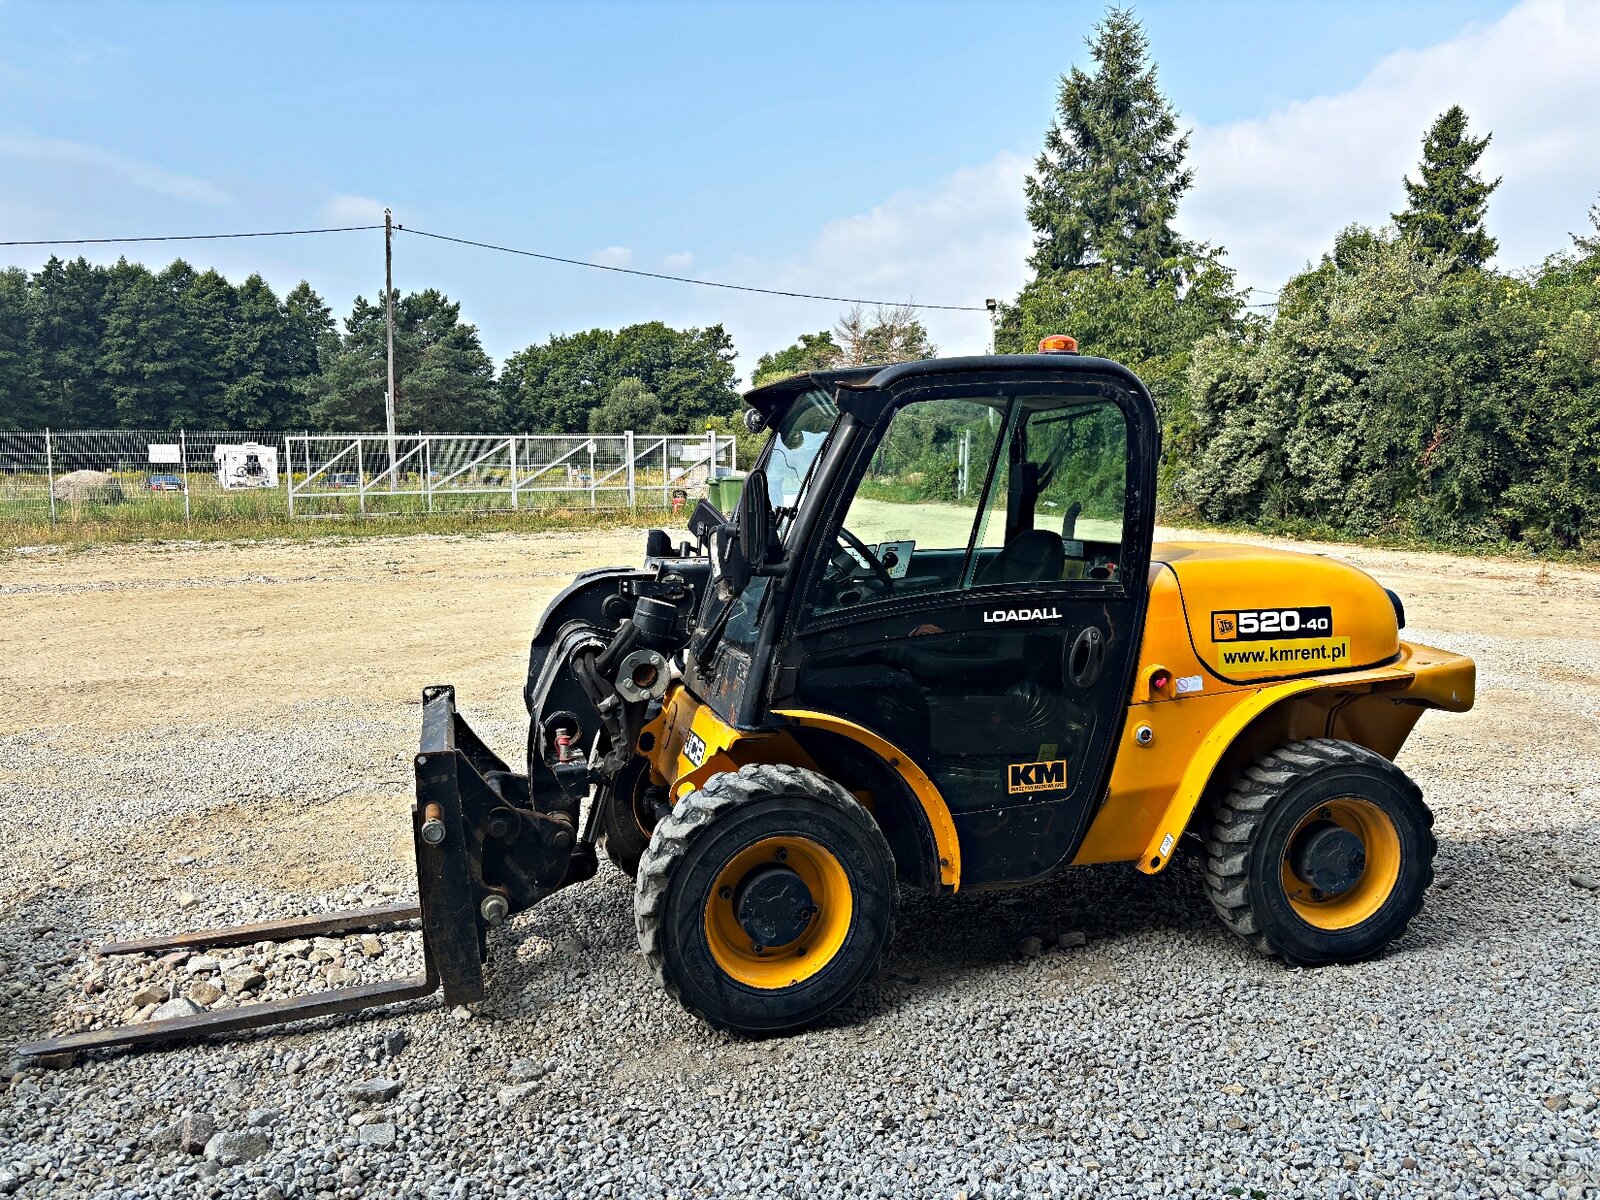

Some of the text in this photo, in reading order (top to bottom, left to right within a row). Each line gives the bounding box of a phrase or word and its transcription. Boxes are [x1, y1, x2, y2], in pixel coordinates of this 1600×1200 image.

[983, 607, 1062, 622] LOADALL
[1223, 643, 1346, 664] www.kmrent.pl
[1011, 763, 1064, 786] KM
